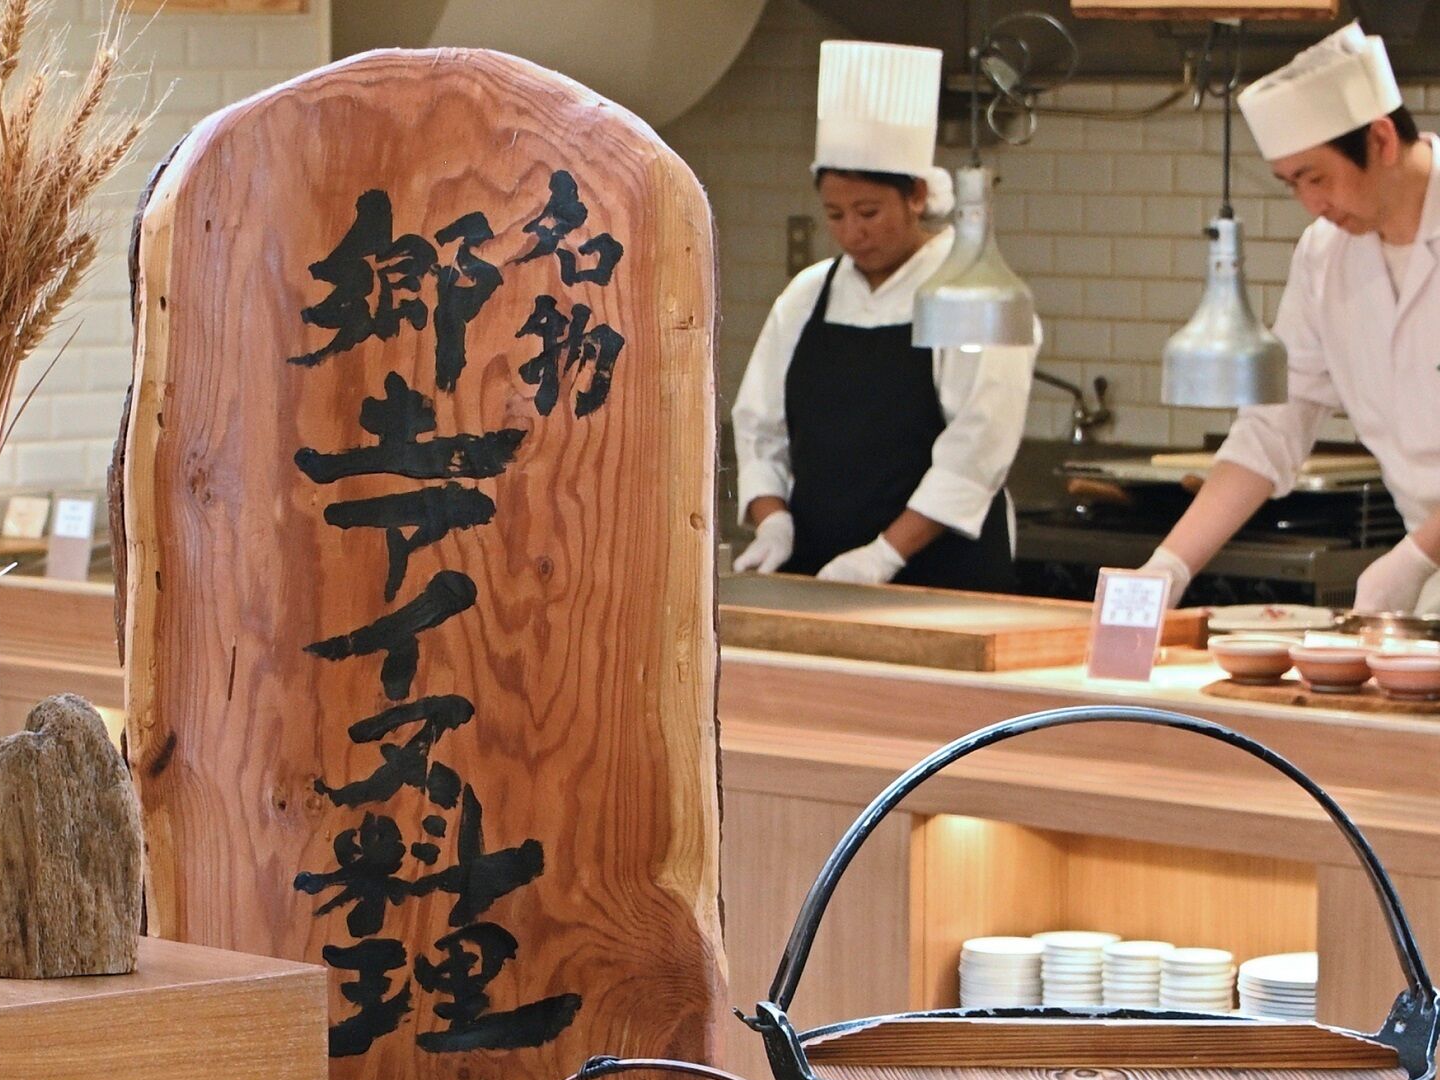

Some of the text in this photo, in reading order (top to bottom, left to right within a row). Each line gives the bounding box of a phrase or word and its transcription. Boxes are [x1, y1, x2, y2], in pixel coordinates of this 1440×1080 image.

[515, 169, 625, 418] 名物
[287, 188, 582, 1058] 郷土アイヌ料理
